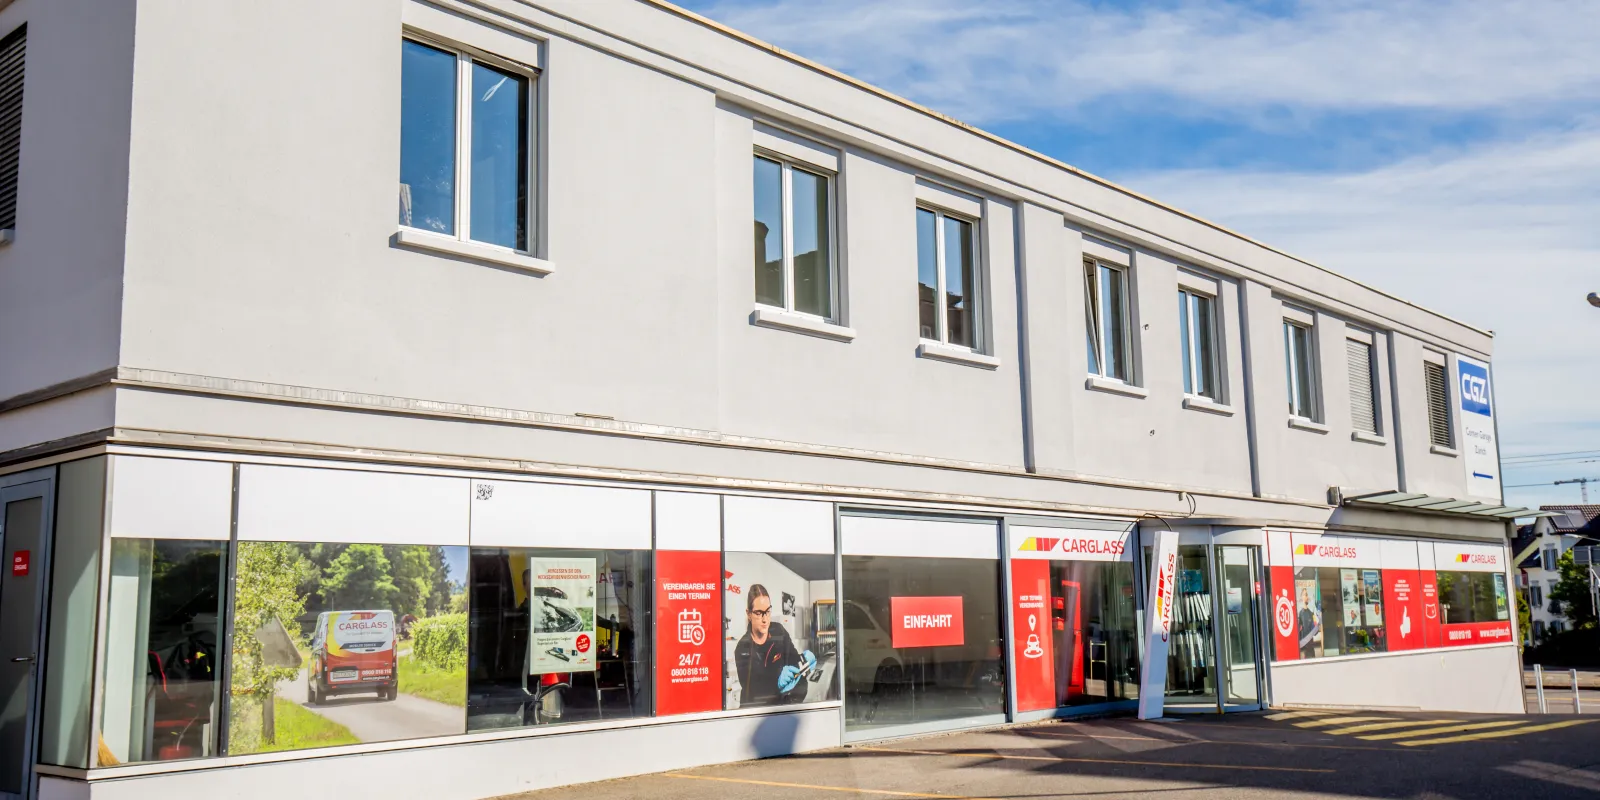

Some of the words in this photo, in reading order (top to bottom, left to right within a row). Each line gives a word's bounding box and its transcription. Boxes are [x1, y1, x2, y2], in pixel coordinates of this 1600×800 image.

[1462, 373, 1487, 405] CGZ
[1062, 538, 1125, 555] CARGLASS
[1318, 546, 1357, 559] CARGLASS
[1471, 554, 1496, 564] CARGLASS
[663, 583, 705, 591] VEREINBAREN
[1161, 553, 1175, 643] CARGLASS
[903, 614, 952, 629] EINFAHRT
[1280, 607, 1290, 624] 30
[339, 621, 388, 631] CARGLASS
[678, 653, 702, 666] 24/7
[671, 669, 687, 677] 0800
[687, 668, 698, 676] 818
[699, 667, 709, 675] 118
[671, 676, 709, 684] www.carglass.ch
